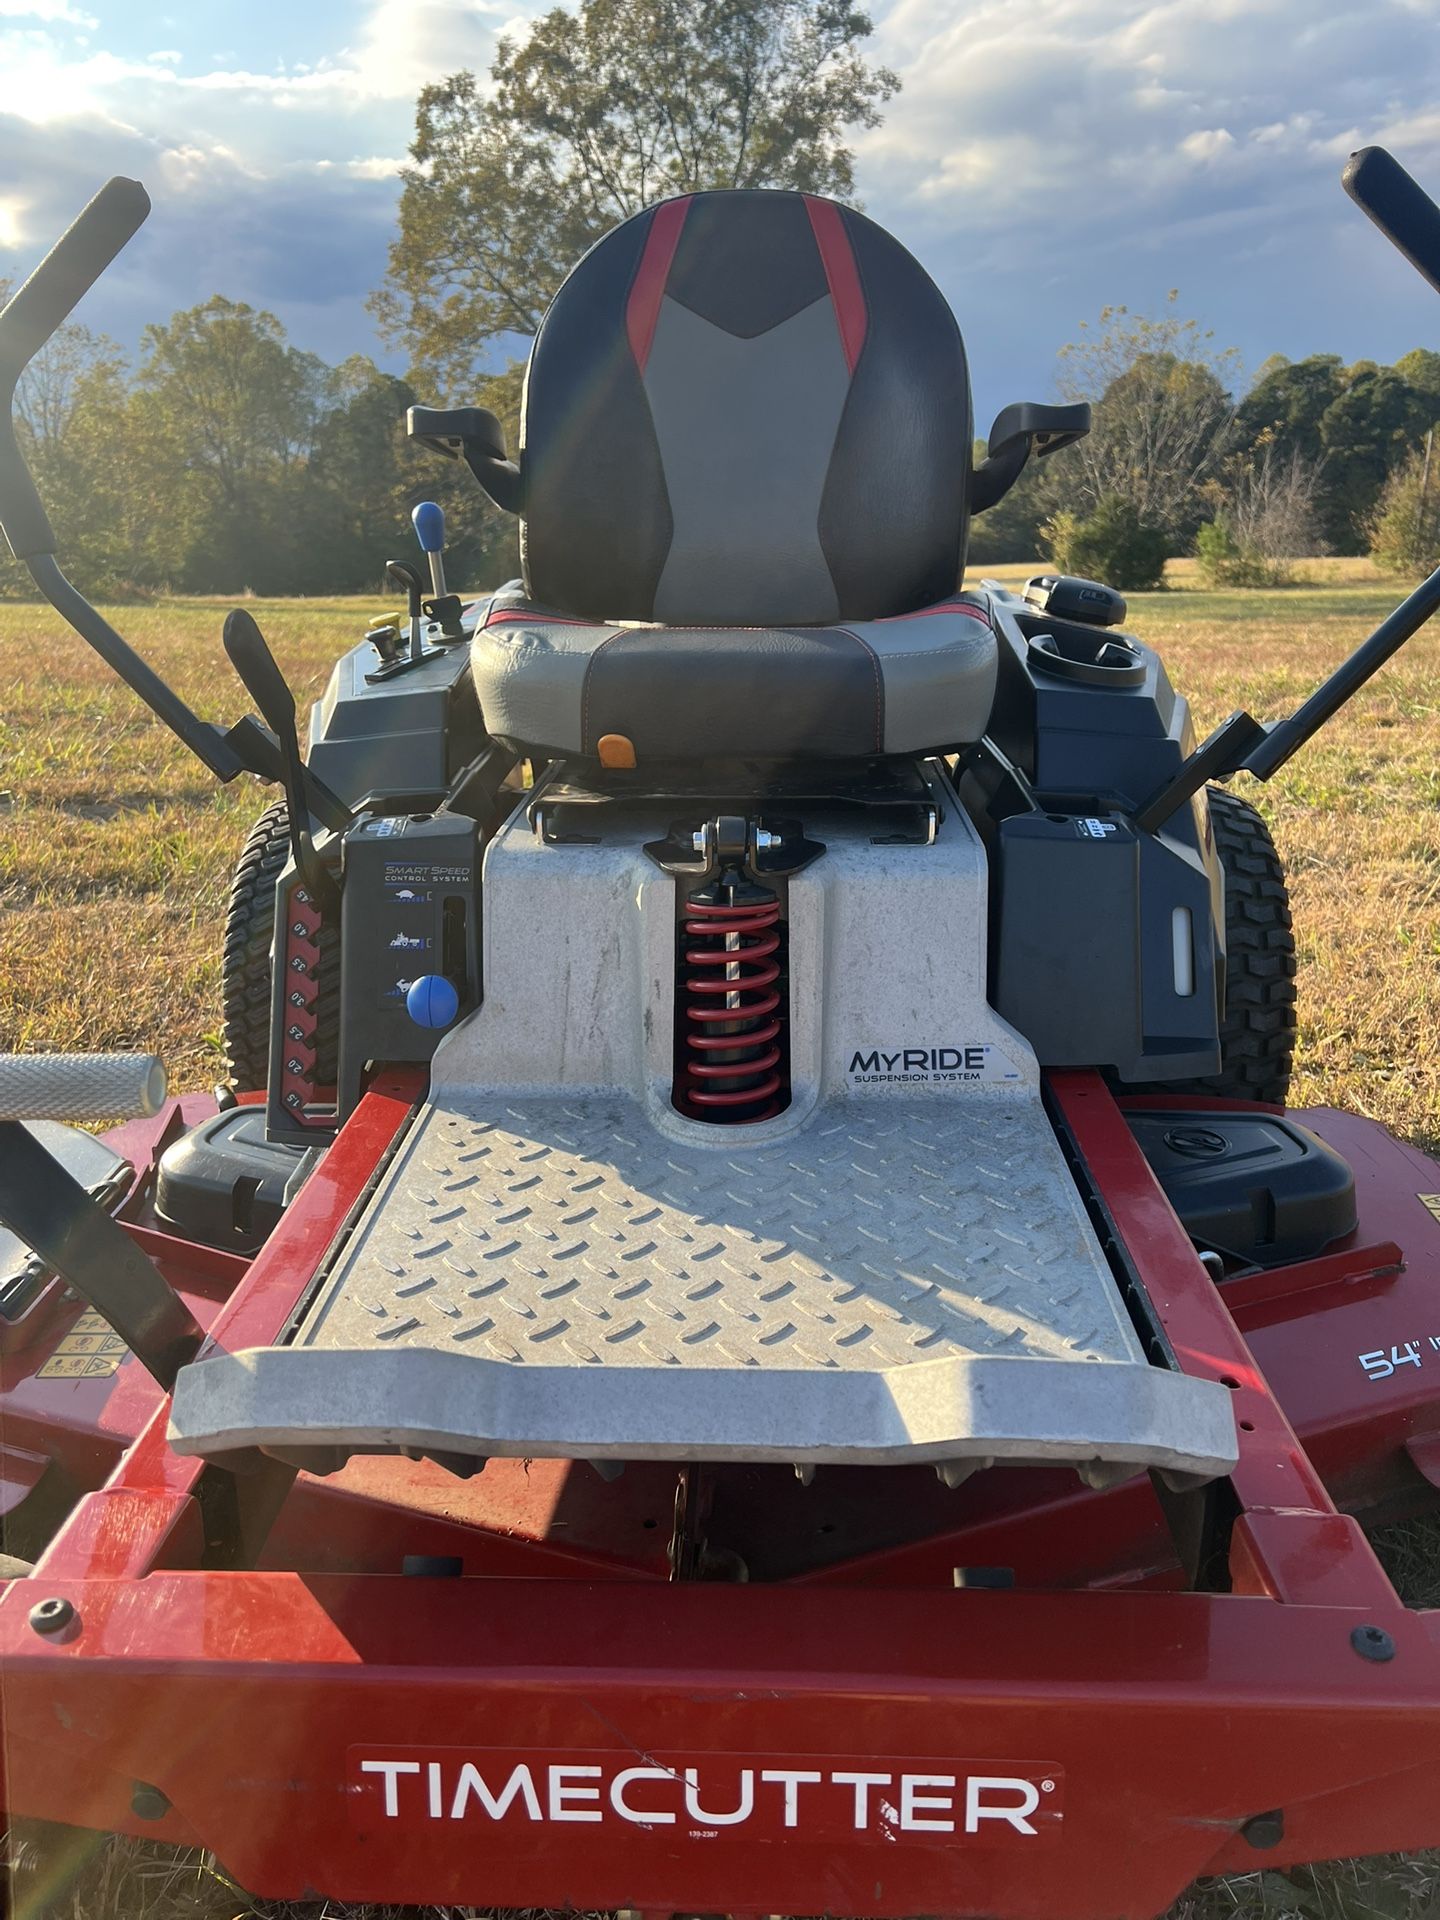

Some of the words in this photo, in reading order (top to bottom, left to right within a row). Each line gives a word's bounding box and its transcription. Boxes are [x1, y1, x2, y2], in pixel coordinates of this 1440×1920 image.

[294, 923, 307, 936] 4.0
[292, 957, 306, 971] 3.5
[291, 992, 305, 1005] 3.0
[289, 1026, 303, 1040] 2.5
[288, 1060, 301, 1073] 2.0
[854, 1074, 929, 1083] SUSPENSION
[933, 1072, 981, 1081] SYSTEM
[286, 1093, 300, 1107] 1.5
